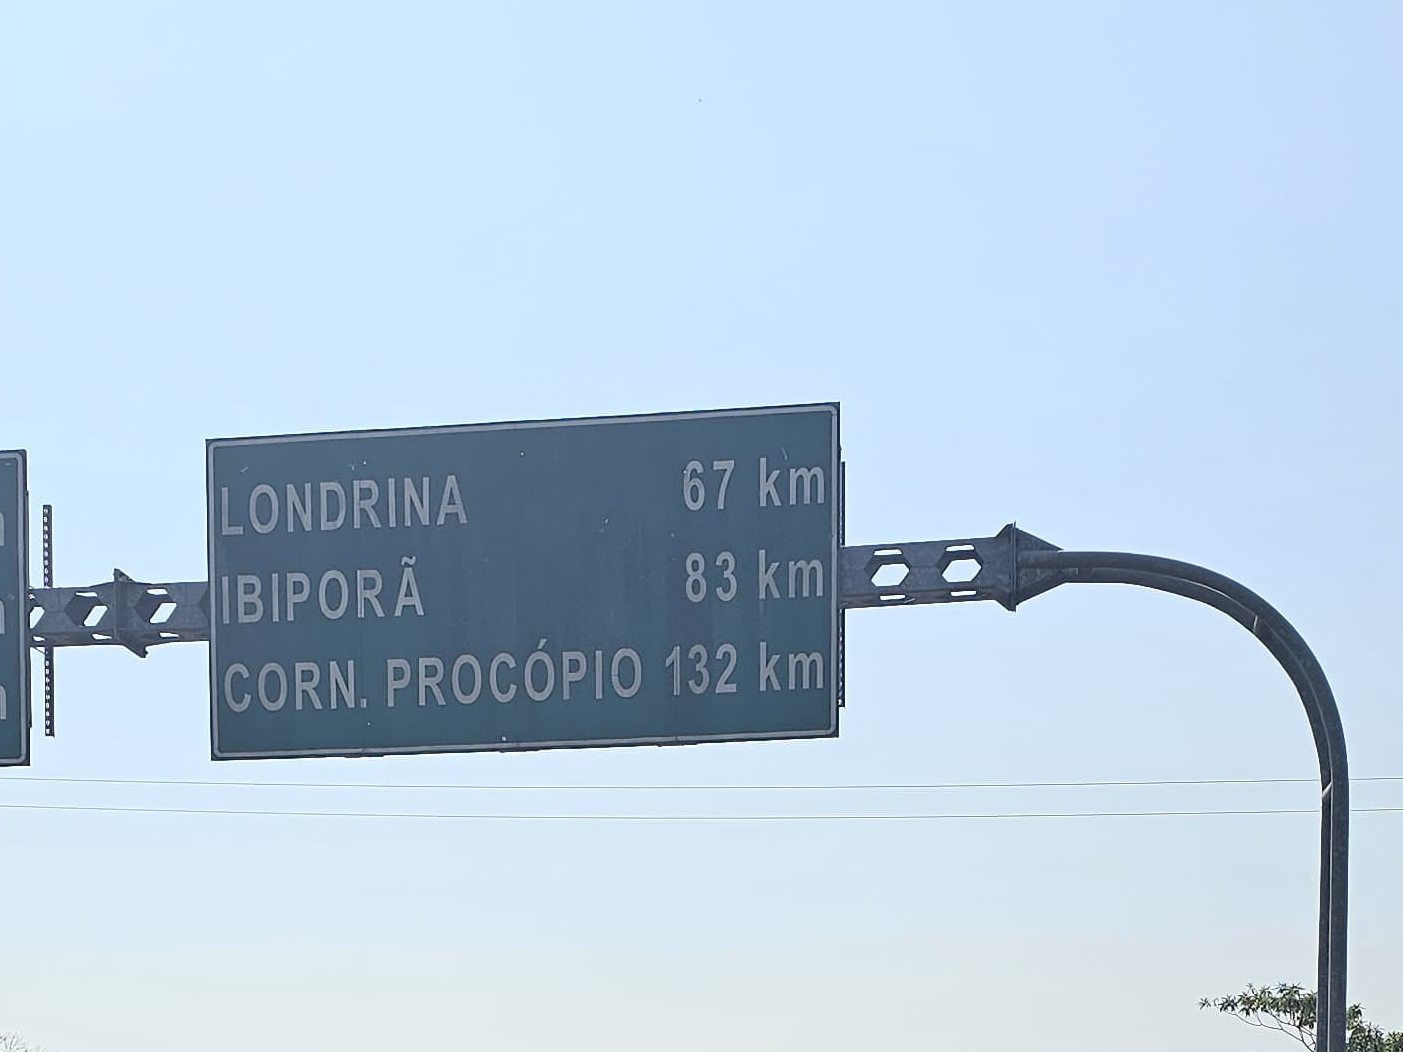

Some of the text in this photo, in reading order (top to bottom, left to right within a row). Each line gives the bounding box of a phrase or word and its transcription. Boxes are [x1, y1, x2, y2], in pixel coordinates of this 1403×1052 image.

[221, 458, 825, 536] LONDRINA 67 km
[221, 549, 824, 625] IBIPORÃ 83 km
[224, 638, 825, 714] CORN. PROCÓPIO 132 km
